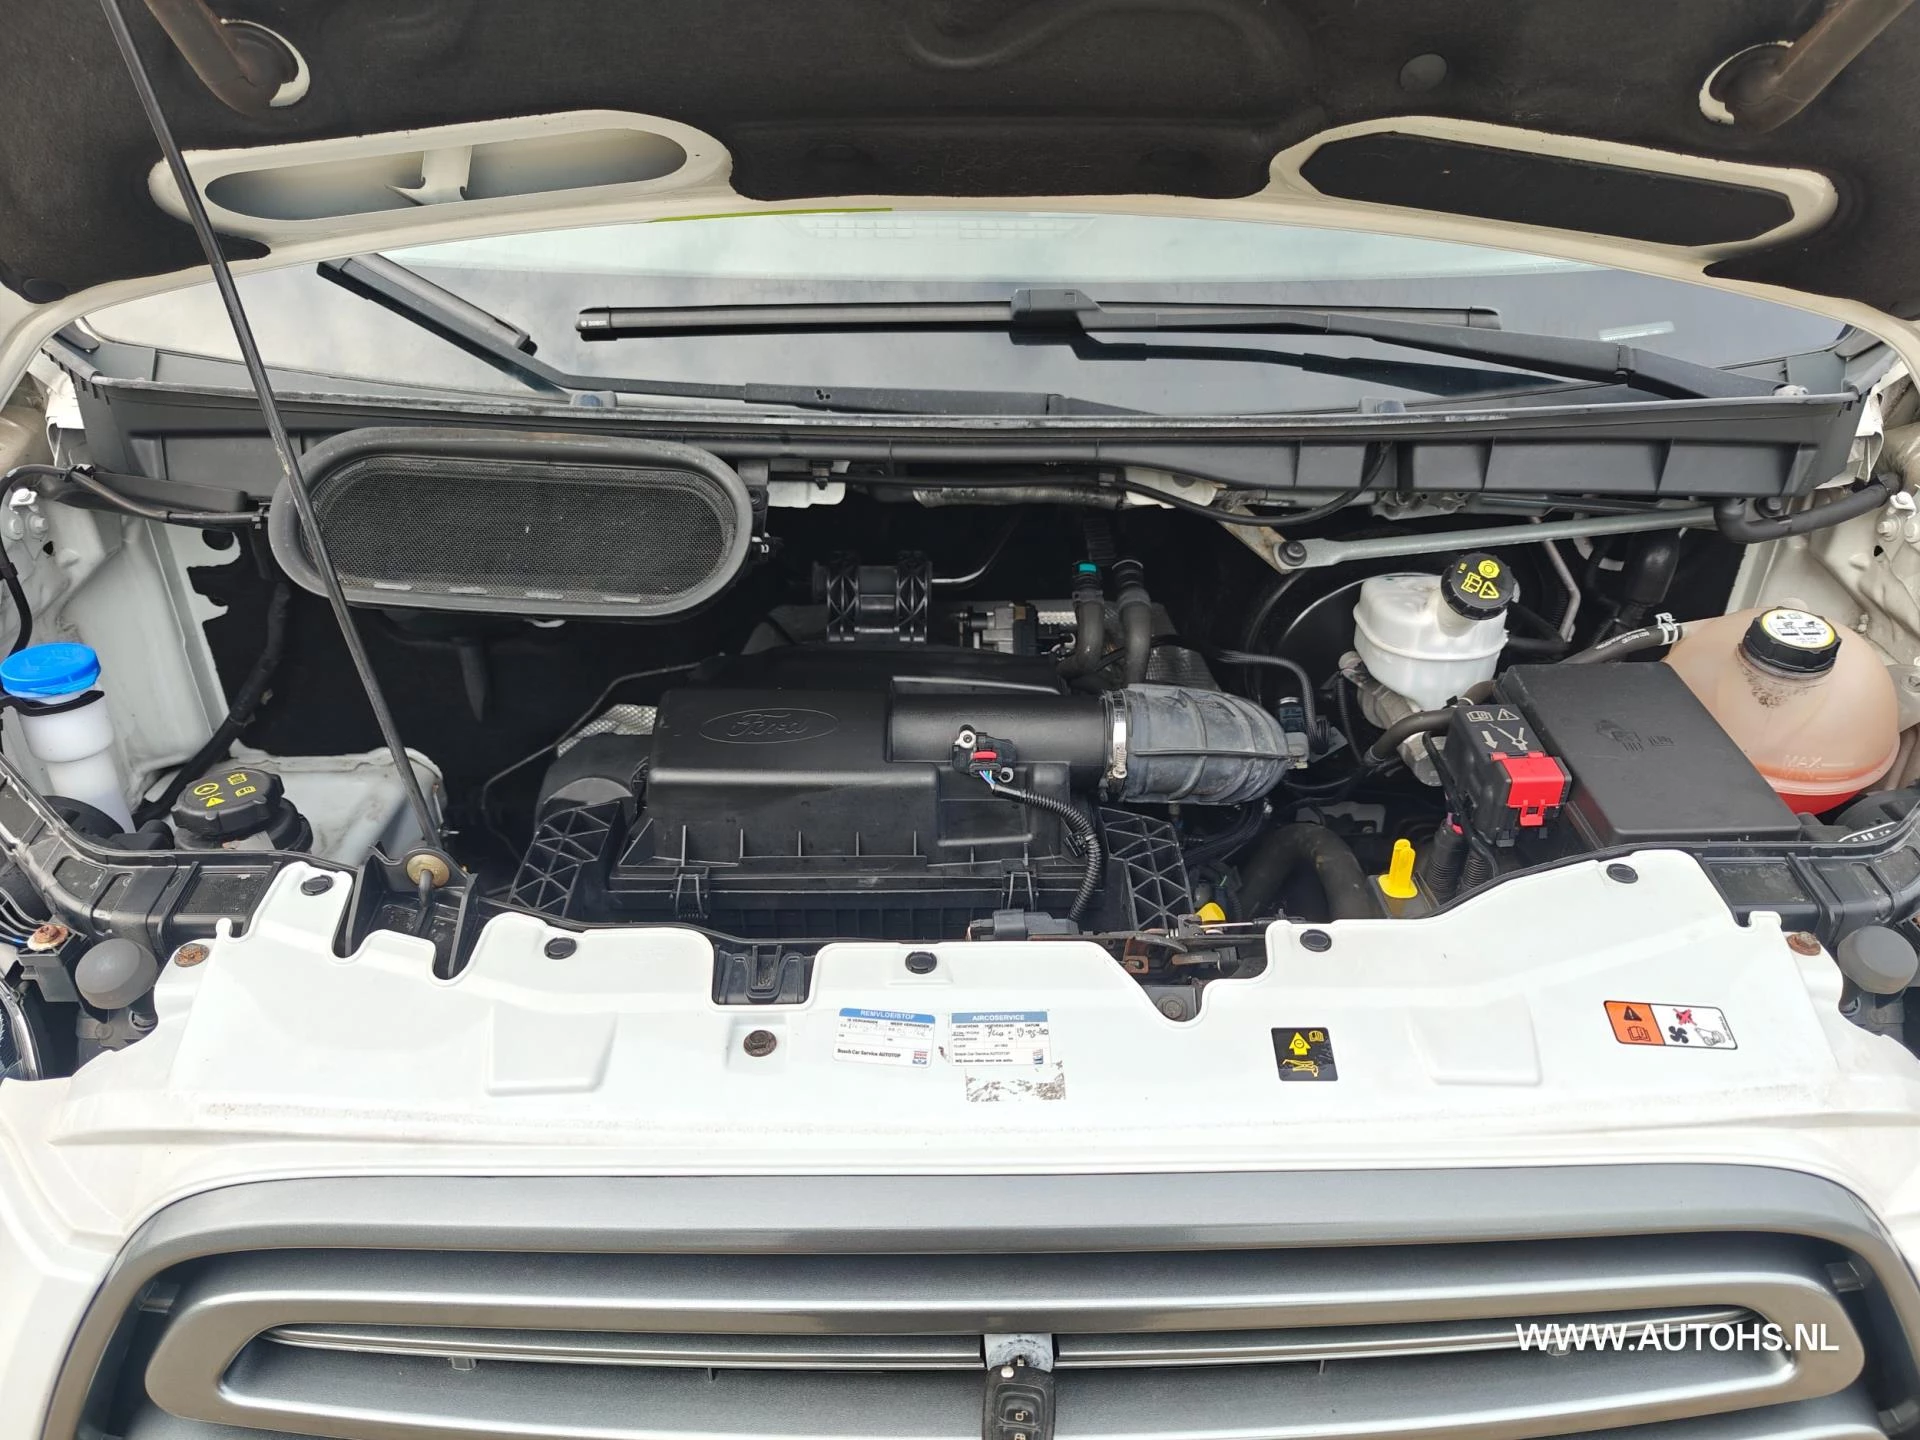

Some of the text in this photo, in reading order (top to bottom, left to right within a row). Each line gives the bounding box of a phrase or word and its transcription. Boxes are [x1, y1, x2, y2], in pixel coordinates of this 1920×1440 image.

[727, 713, 808, 737] Ford
[1784, 754, 1822, 769] MAX
[972, 1014, 1025, 1022] AIRCOSERVICE
